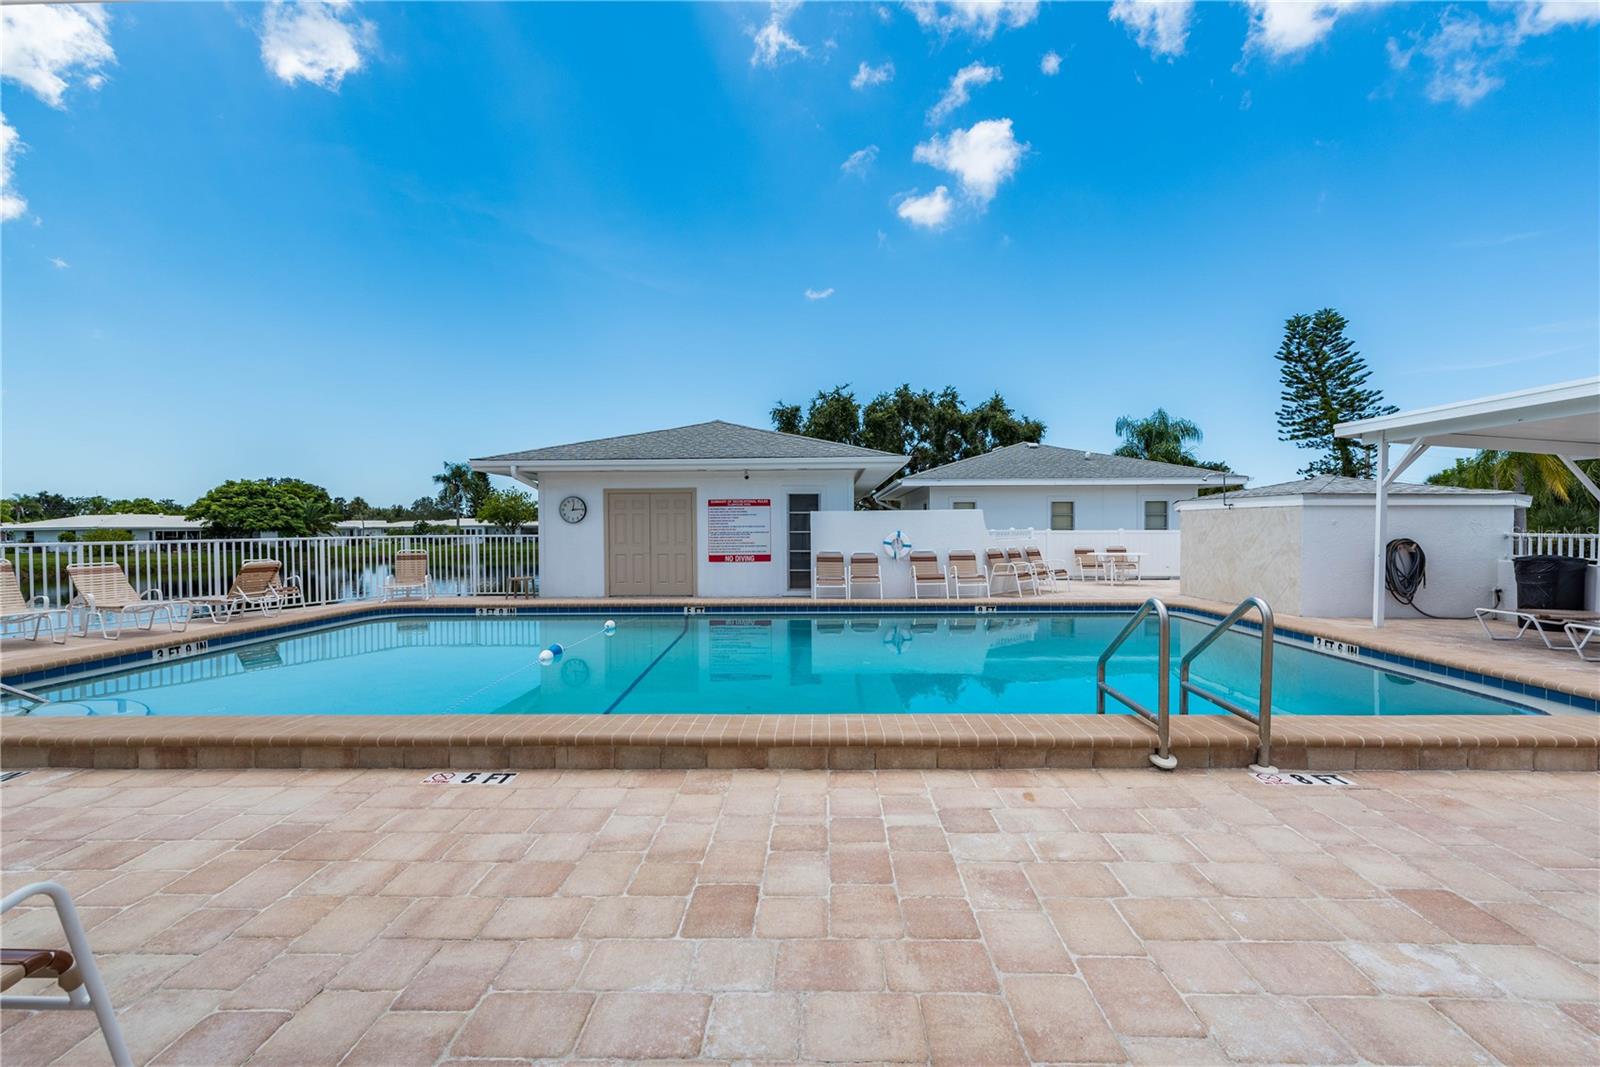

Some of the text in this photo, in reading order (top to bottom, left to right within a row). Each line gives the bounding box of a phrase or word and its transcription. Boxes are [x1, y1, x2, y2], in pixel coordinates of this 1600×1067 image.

[168, 646, 181, 655] FT
[196, 640, 207, 650] IN
[461, 772, 482, 784] 5
[482, 773, 517, 784] FT
[1289, 774, 1349, 785] 8 FT
